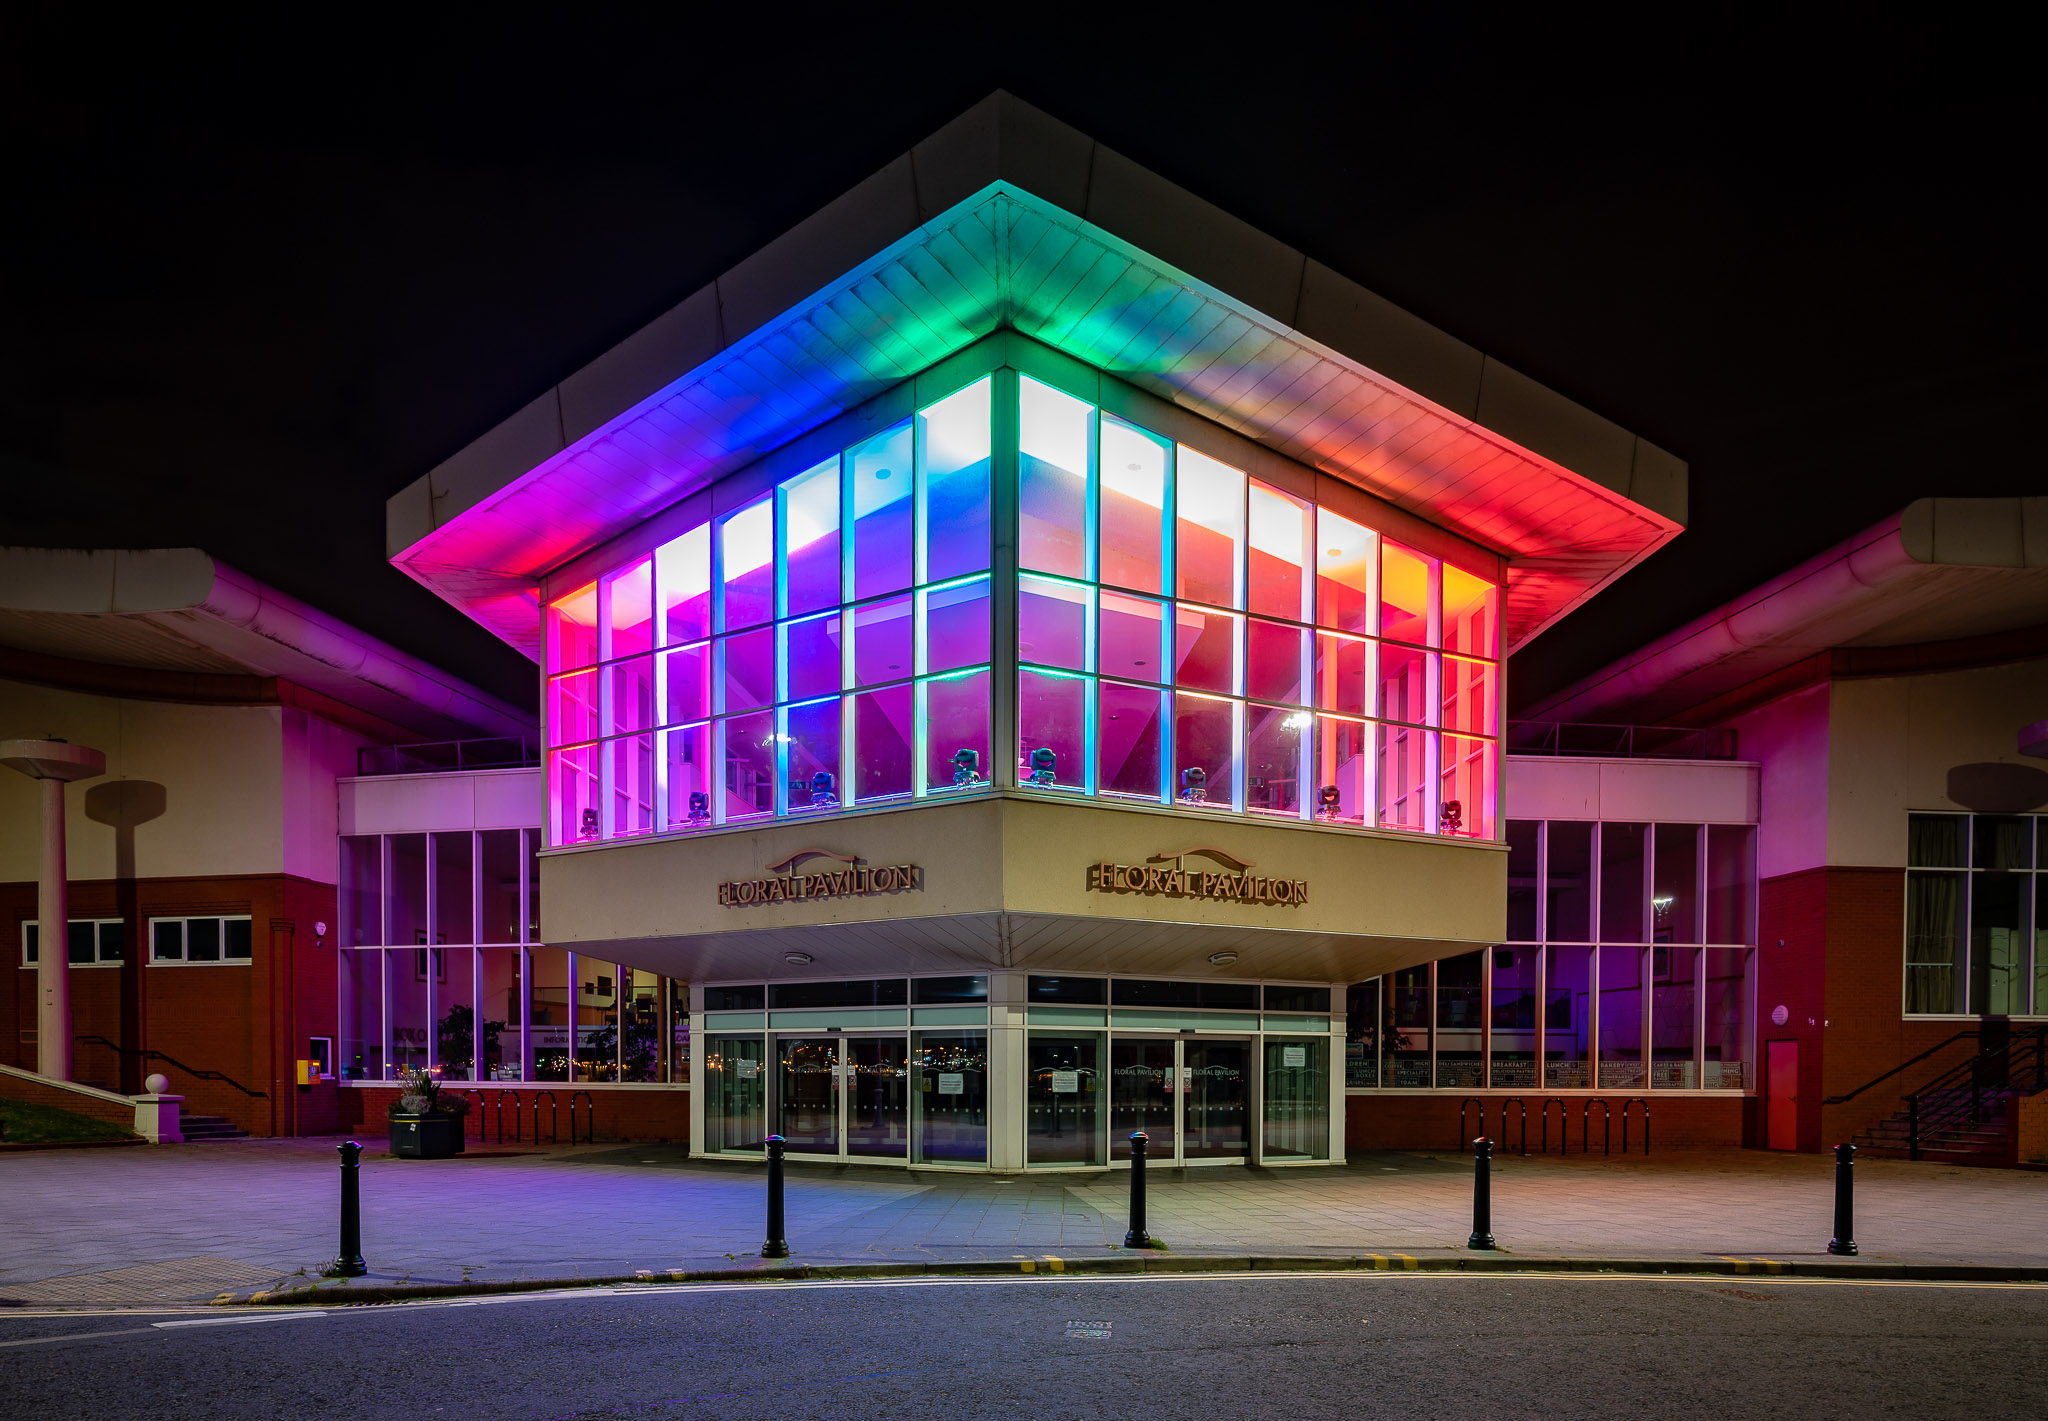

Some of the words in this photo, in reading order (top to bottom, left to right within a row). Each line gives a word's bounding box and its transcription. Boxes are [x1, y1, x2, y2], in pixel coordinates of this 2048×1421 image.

[717, 876, 797, 905] FLORAL
[803, 863, 914, 898] PAVILION
[1099, 862, 1195, 894] FLORAL
[1202, 871, 1308, 903] PAVILION
[393, 1027, 416, 1042] BOX
